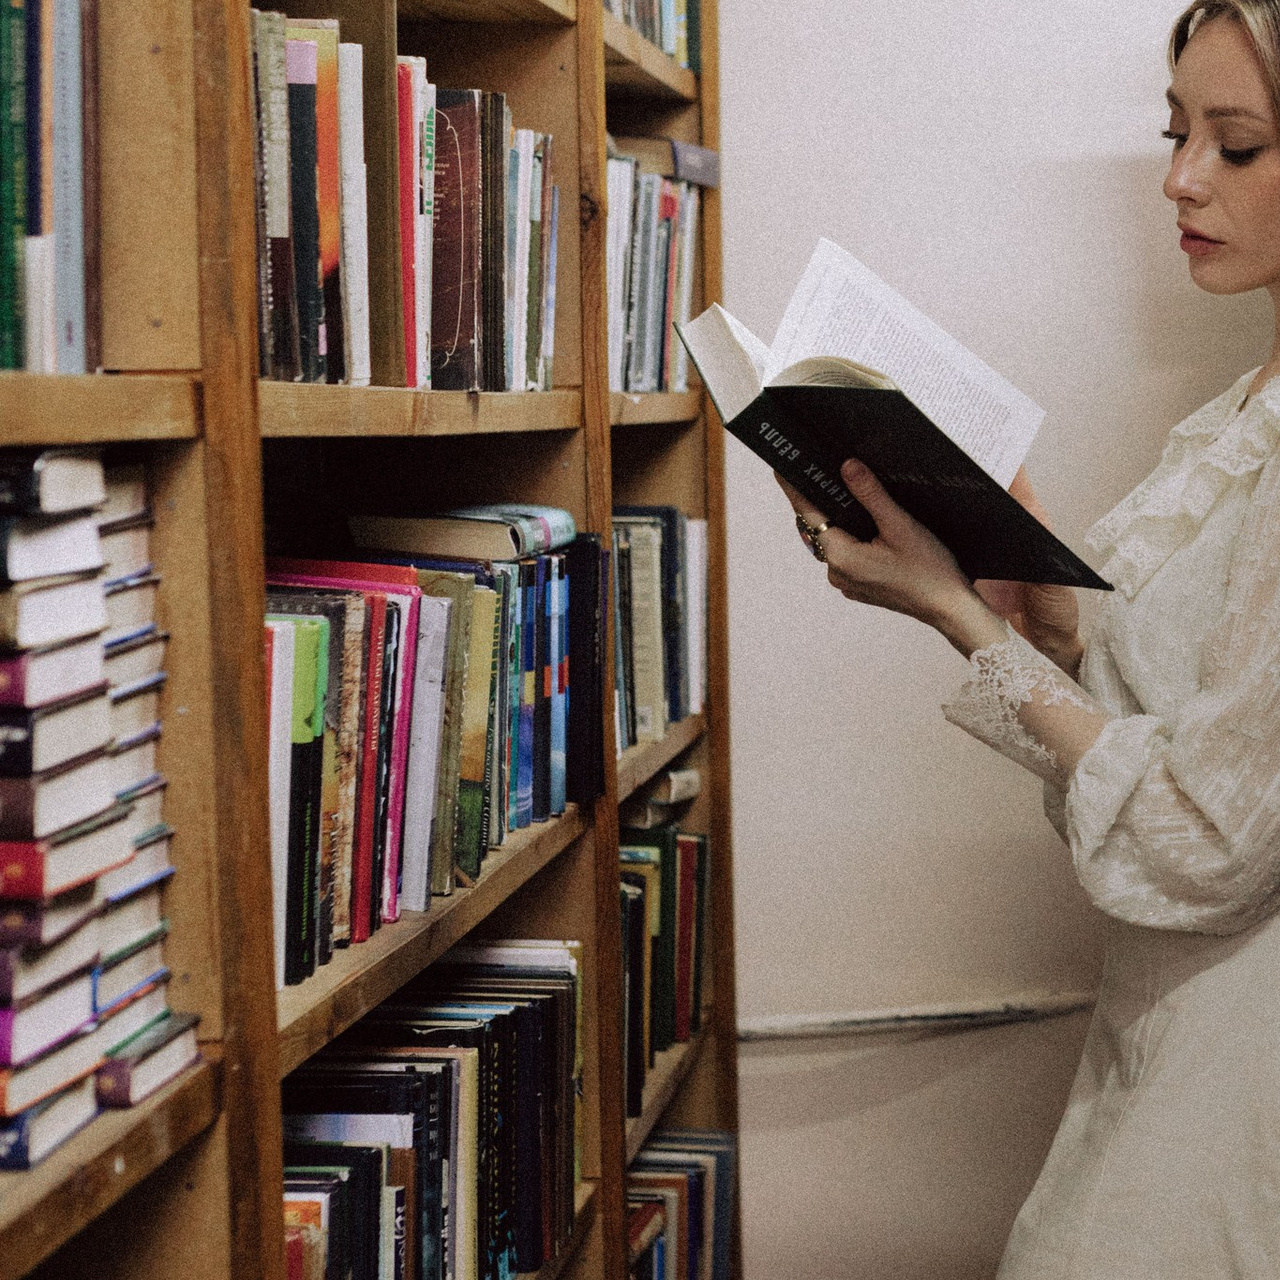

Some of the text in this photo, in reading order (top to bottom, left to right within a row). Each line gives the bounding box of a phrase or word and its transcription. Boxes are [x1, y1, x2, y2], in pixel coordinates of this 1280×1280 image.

[758, 422, 801, 462] БЁЛЛЬ
[804, 463, 855, 508] ГЕНРИХ
[374, 626, 385, 679] АНГЕЛЫ
[370, 690, 381, 750] ДЕМОНЫ
